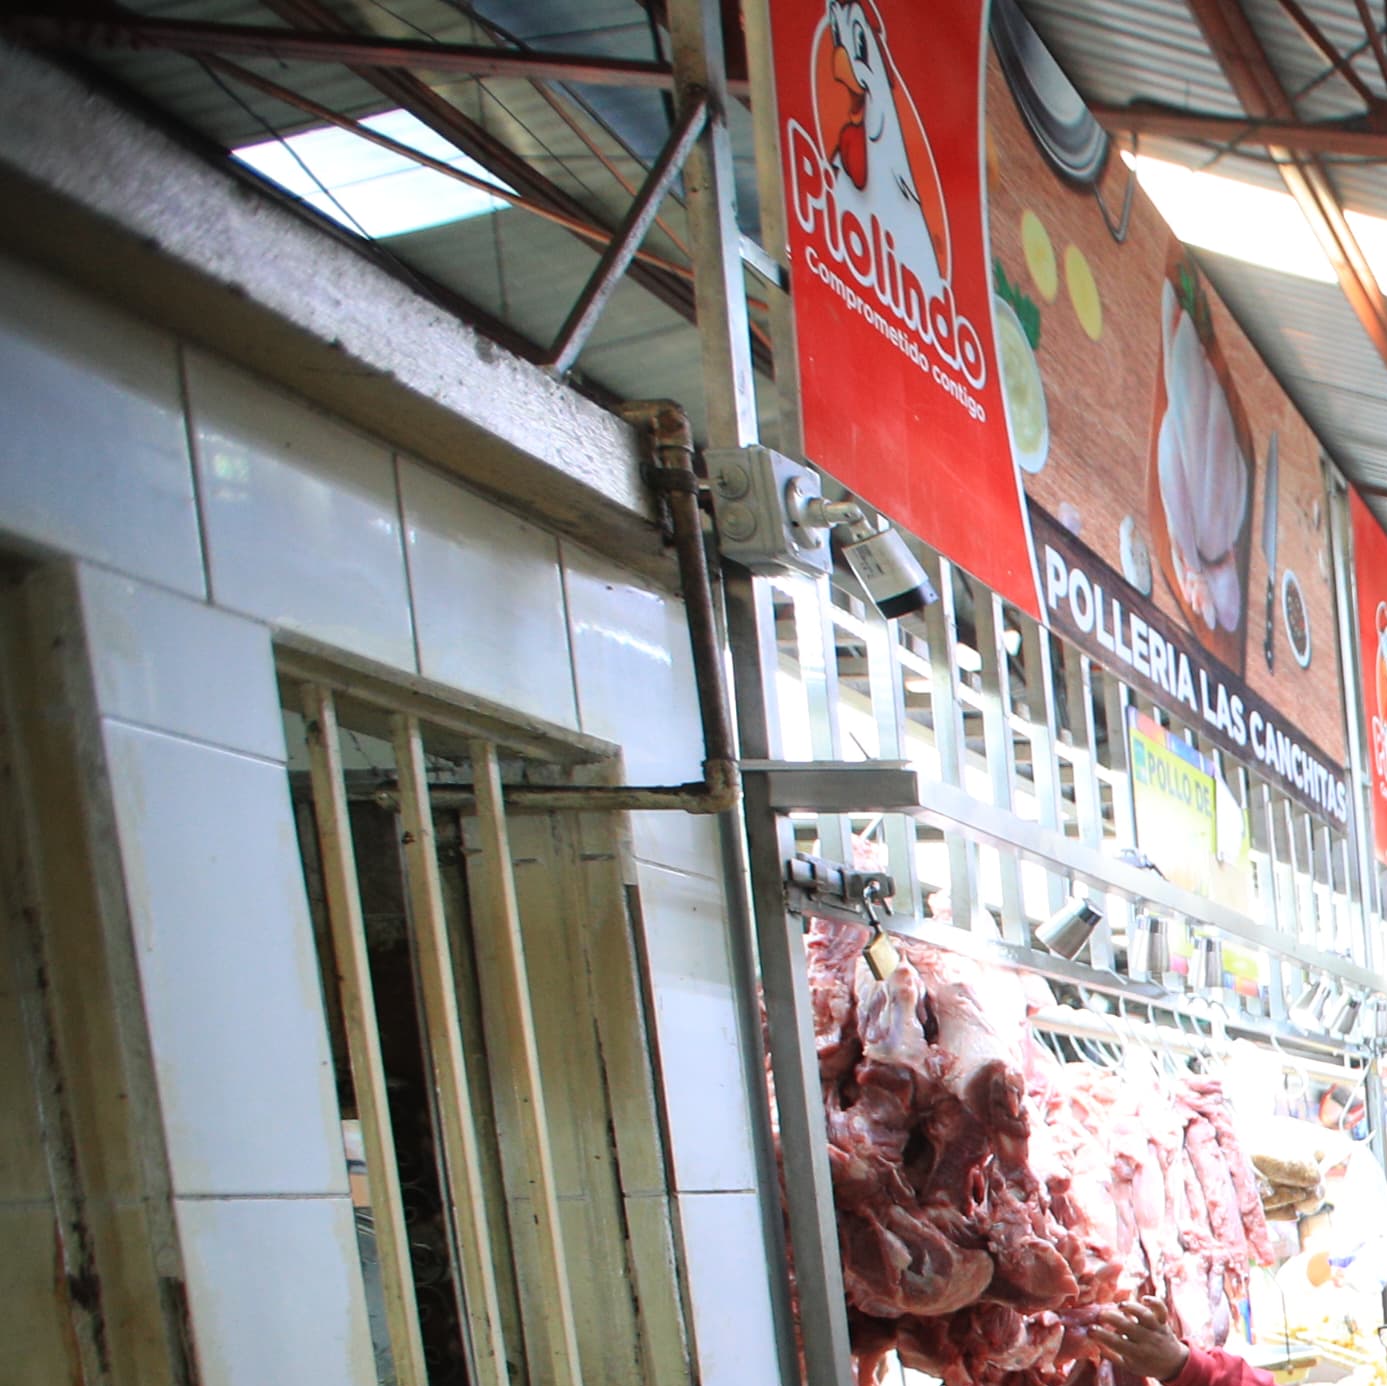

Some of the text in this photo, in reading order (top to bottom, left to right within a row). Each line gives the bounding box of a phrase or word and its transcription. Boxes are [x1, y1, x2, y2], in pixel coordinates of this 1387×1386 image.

[787, 117, 986, 390] Piolindo
[805, 245, 986, 423] Comprometido contigo
[1045, 544, 1198, 711] POLLERIA
[1200, 668, 1247, 746] LAS
[1249, 710, 1347, 823] CANCHITAS
[1148, 750, 1192, 806] POLLO
